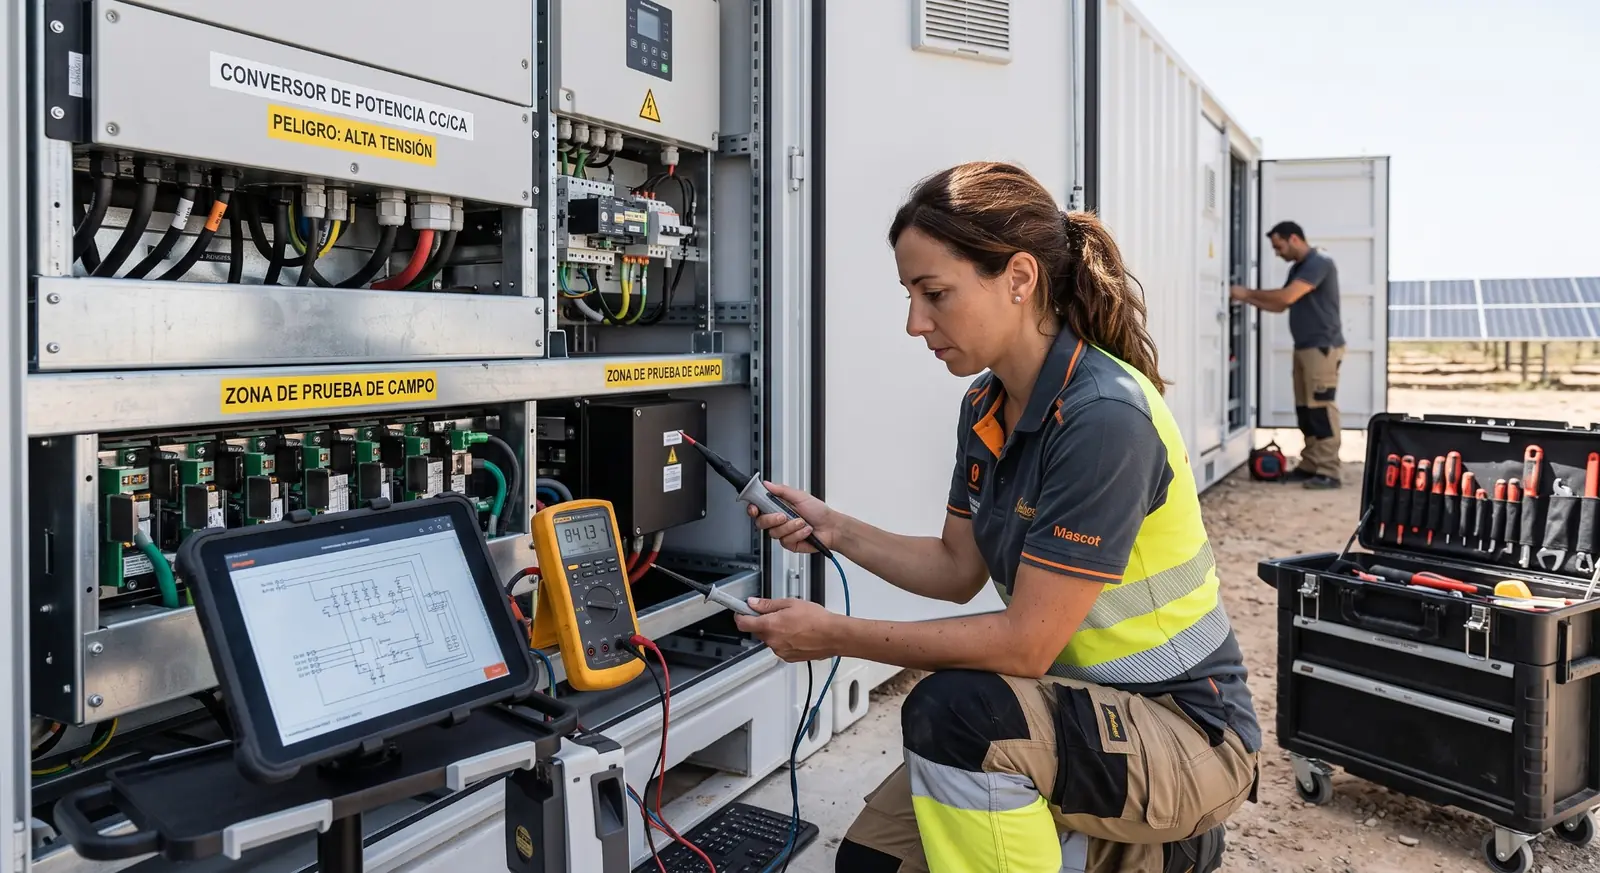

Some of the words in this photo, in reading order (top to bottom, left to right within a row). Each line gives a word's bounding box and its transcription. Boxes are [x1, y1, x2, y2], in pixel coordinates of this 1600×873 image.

[220, 62, 326, 102] CONVERSOR
[332, 87, 351, 107] DE
[356, 93, 426, 123] POTENCIA
[429, 110, 467, 133] CC/CA
[273, 113, 341, 142] PELIGRO:
[345, 128, 377, 148] ALTA
[380, 135, 432, 158] TENSIÓN
[607, 368, 632, 383] ZONA
[634, 368, 645, 381] DE
[648, 366, 680, 380] PRUEBA
[682, 365, 692, 377] DE
[694, 364, 720, 376] CAMPO
[225, 385, 272, 405] ZONA
[277, 384, 298, 401] DE
[303, 381, 362, 400] PRUEBA
[367, 380, 384, 396] DE
[388, 378, 435, 395] CAMPO
[1053, 525, 1102, 547] Mascot
